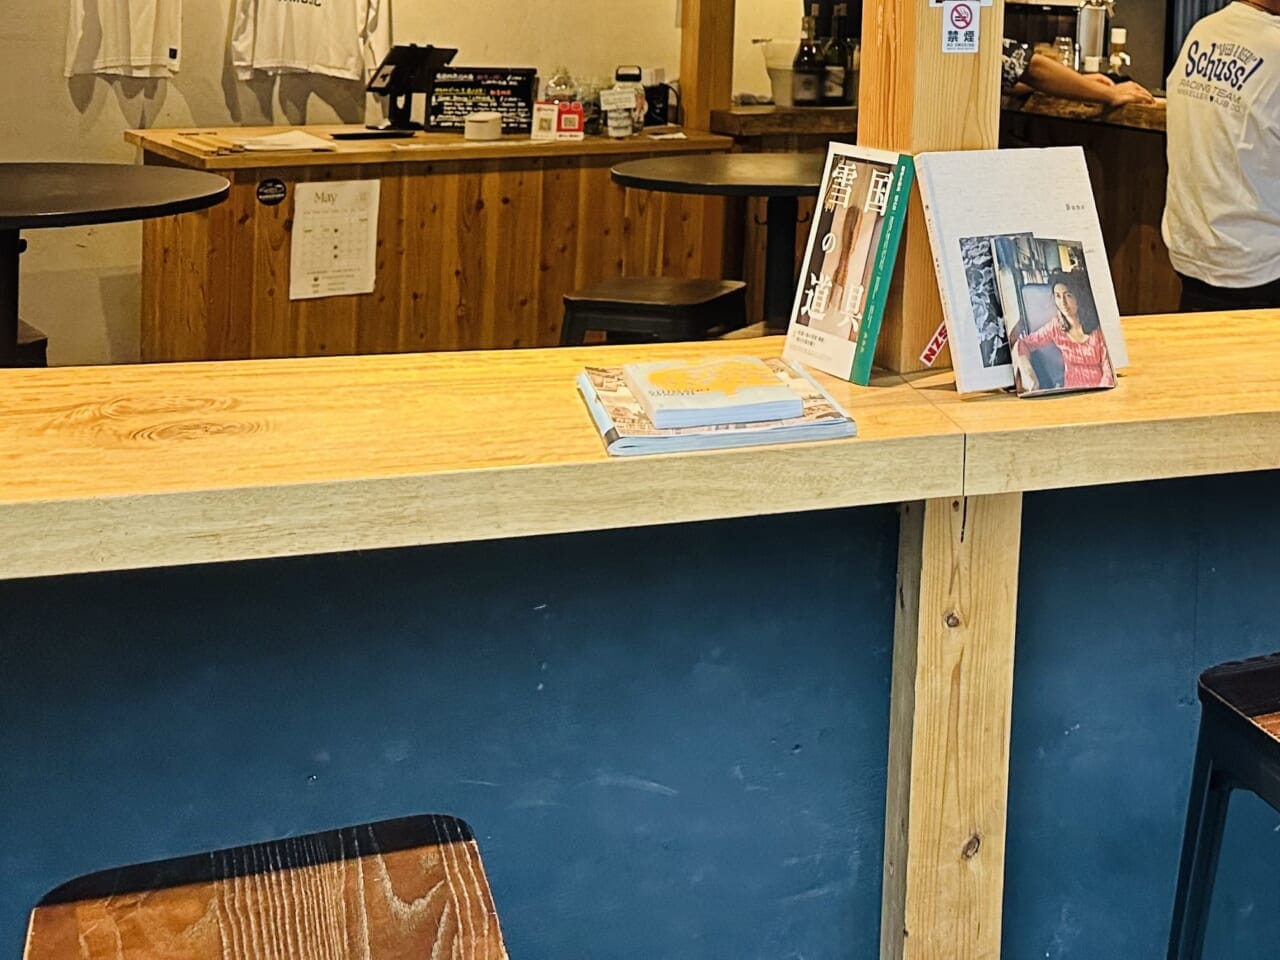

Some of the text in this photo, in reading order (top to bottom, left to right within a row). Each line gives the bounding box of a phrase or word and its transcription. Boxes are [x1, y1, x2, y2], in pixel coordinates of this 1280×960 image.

[947, 30, 975, 43] 禁煙
[1185, 40, 1264, 91] Schuss!
[314, 191, 338, 205] May
